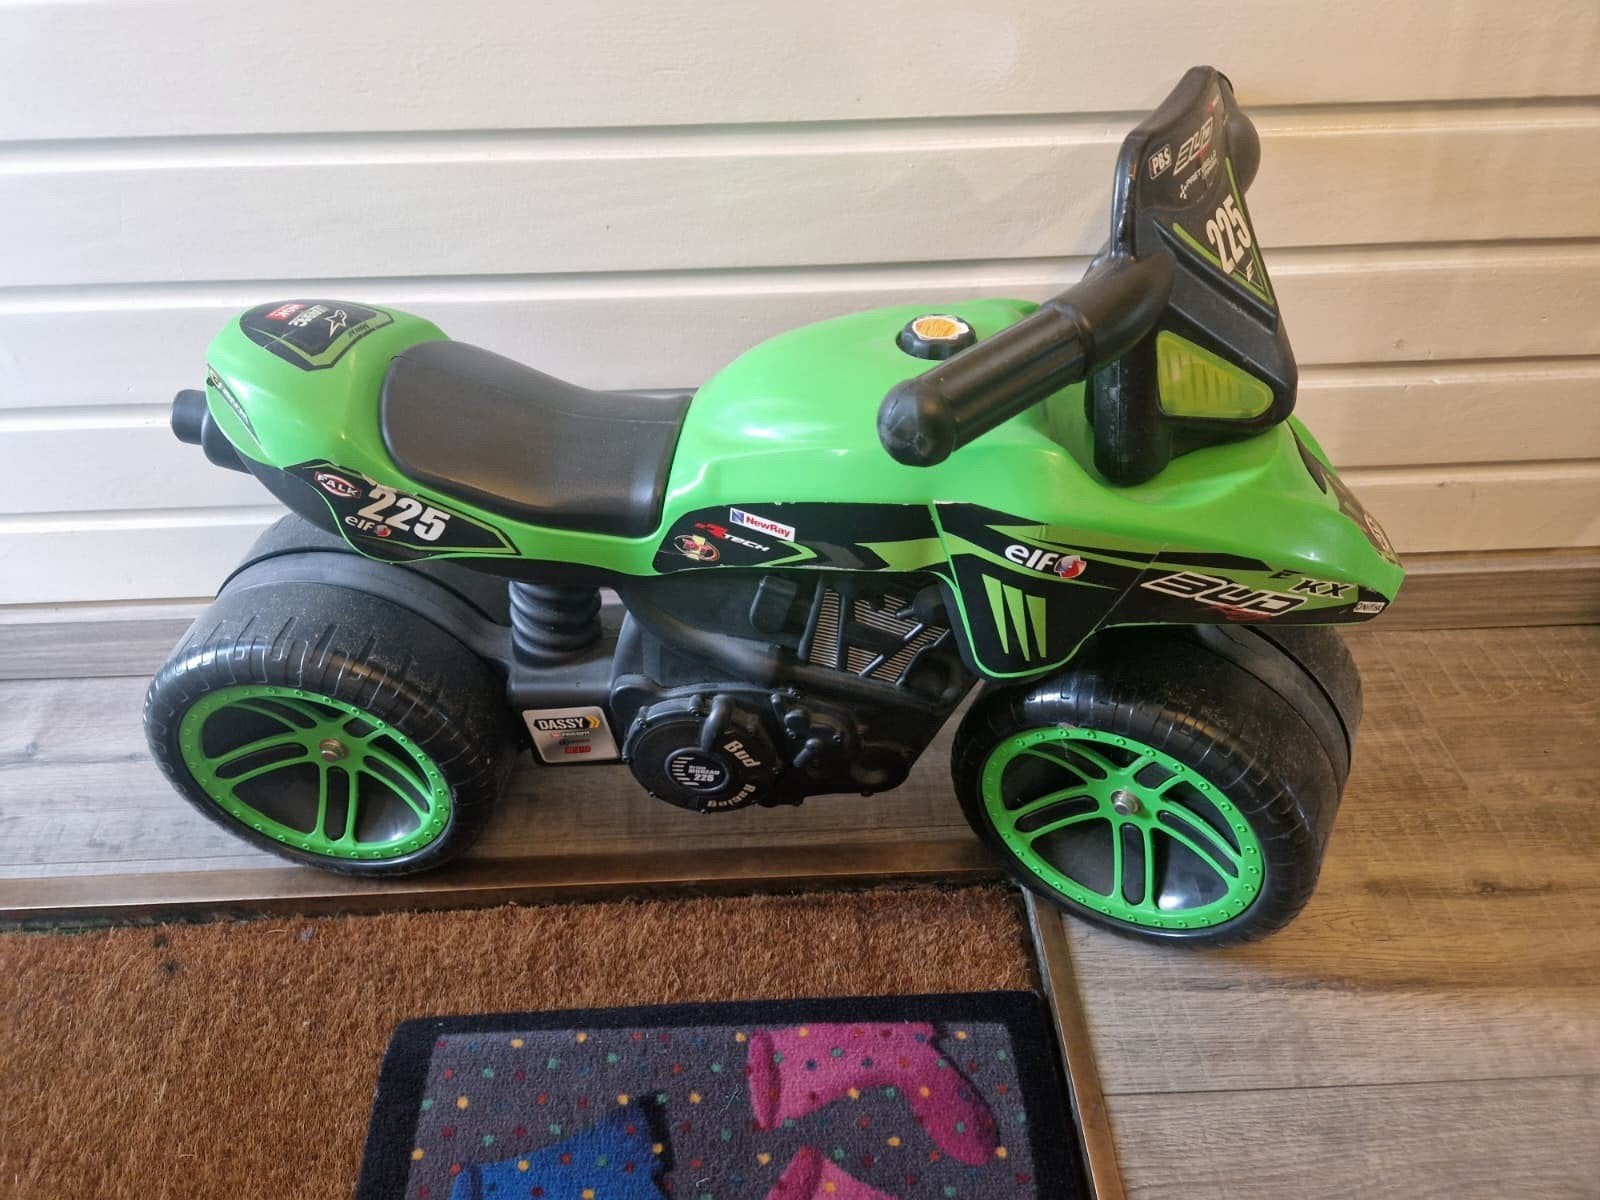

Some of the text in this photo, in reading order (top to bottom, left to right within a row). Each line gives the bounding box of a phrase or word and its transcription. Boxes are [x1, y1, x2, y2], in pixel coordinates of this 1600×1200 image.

[1151, 147, 1170, 175] PBS
[1206, 194, 1251, 275] 225
[316, 472, 361, 497] FALK
[356, 487, 450, 542] 225
[745, 516, 791, 538] NewRay
[1004, 544, 1060, 571] elf
[1288, 577, 1354, 599] KX
[537, 717, 584, 730] DASSY
[723, 740, 761, 768] Bud
